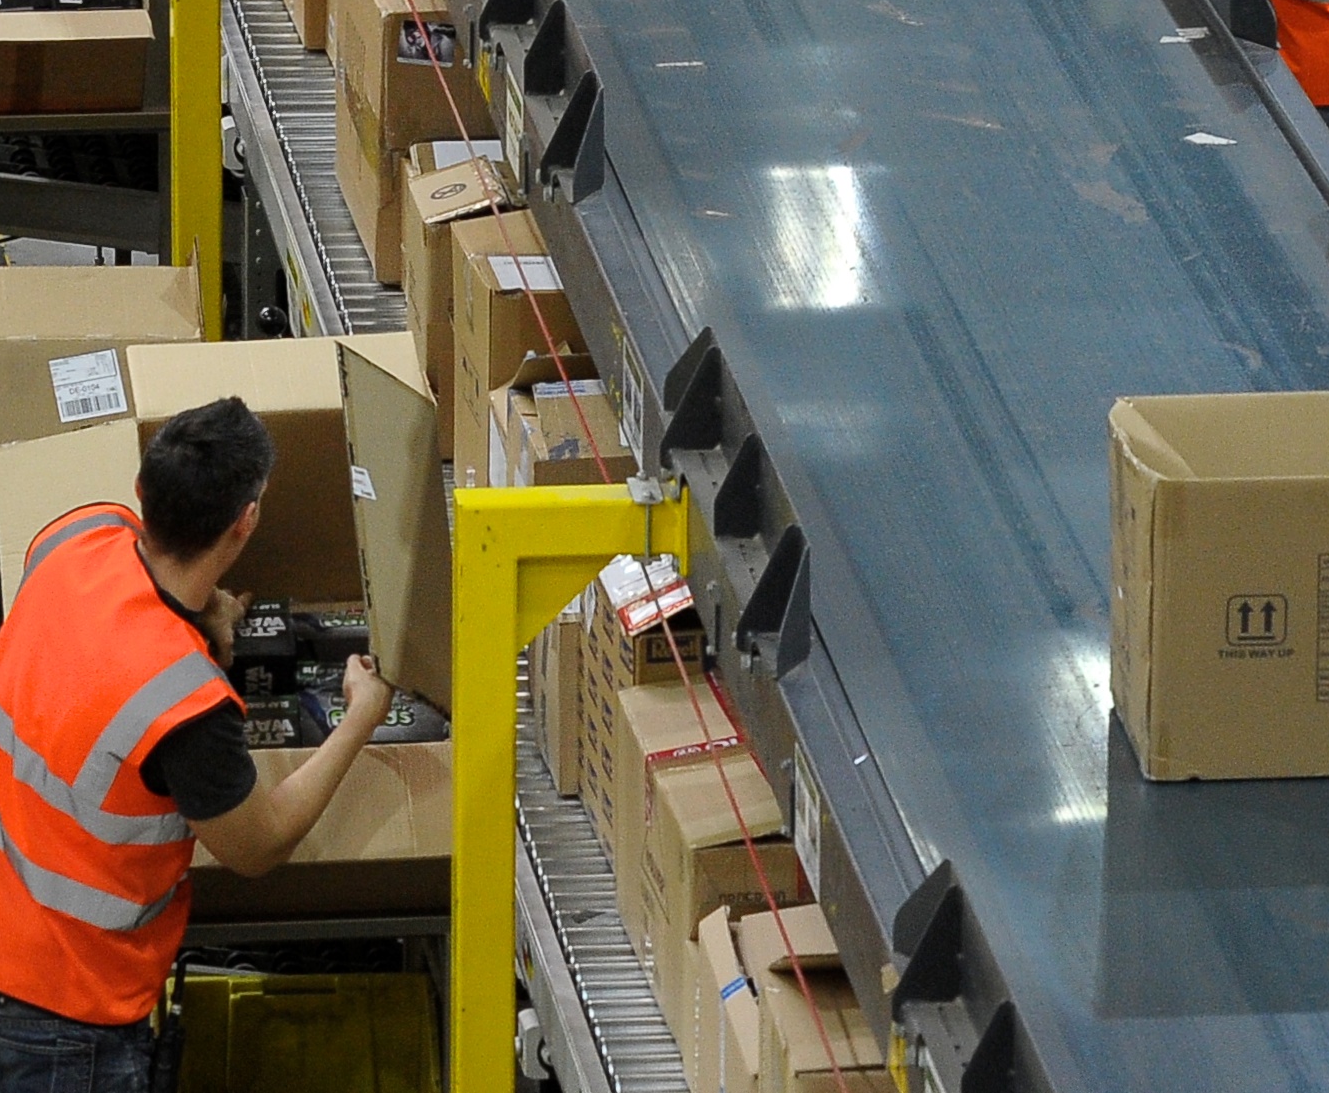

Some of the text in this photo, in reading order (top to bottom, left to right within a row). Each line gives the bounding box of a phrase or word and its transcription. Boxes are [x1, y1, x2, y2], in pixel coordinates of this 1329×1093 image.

[1218, 649, 1294, 659] THIS WAY UP
